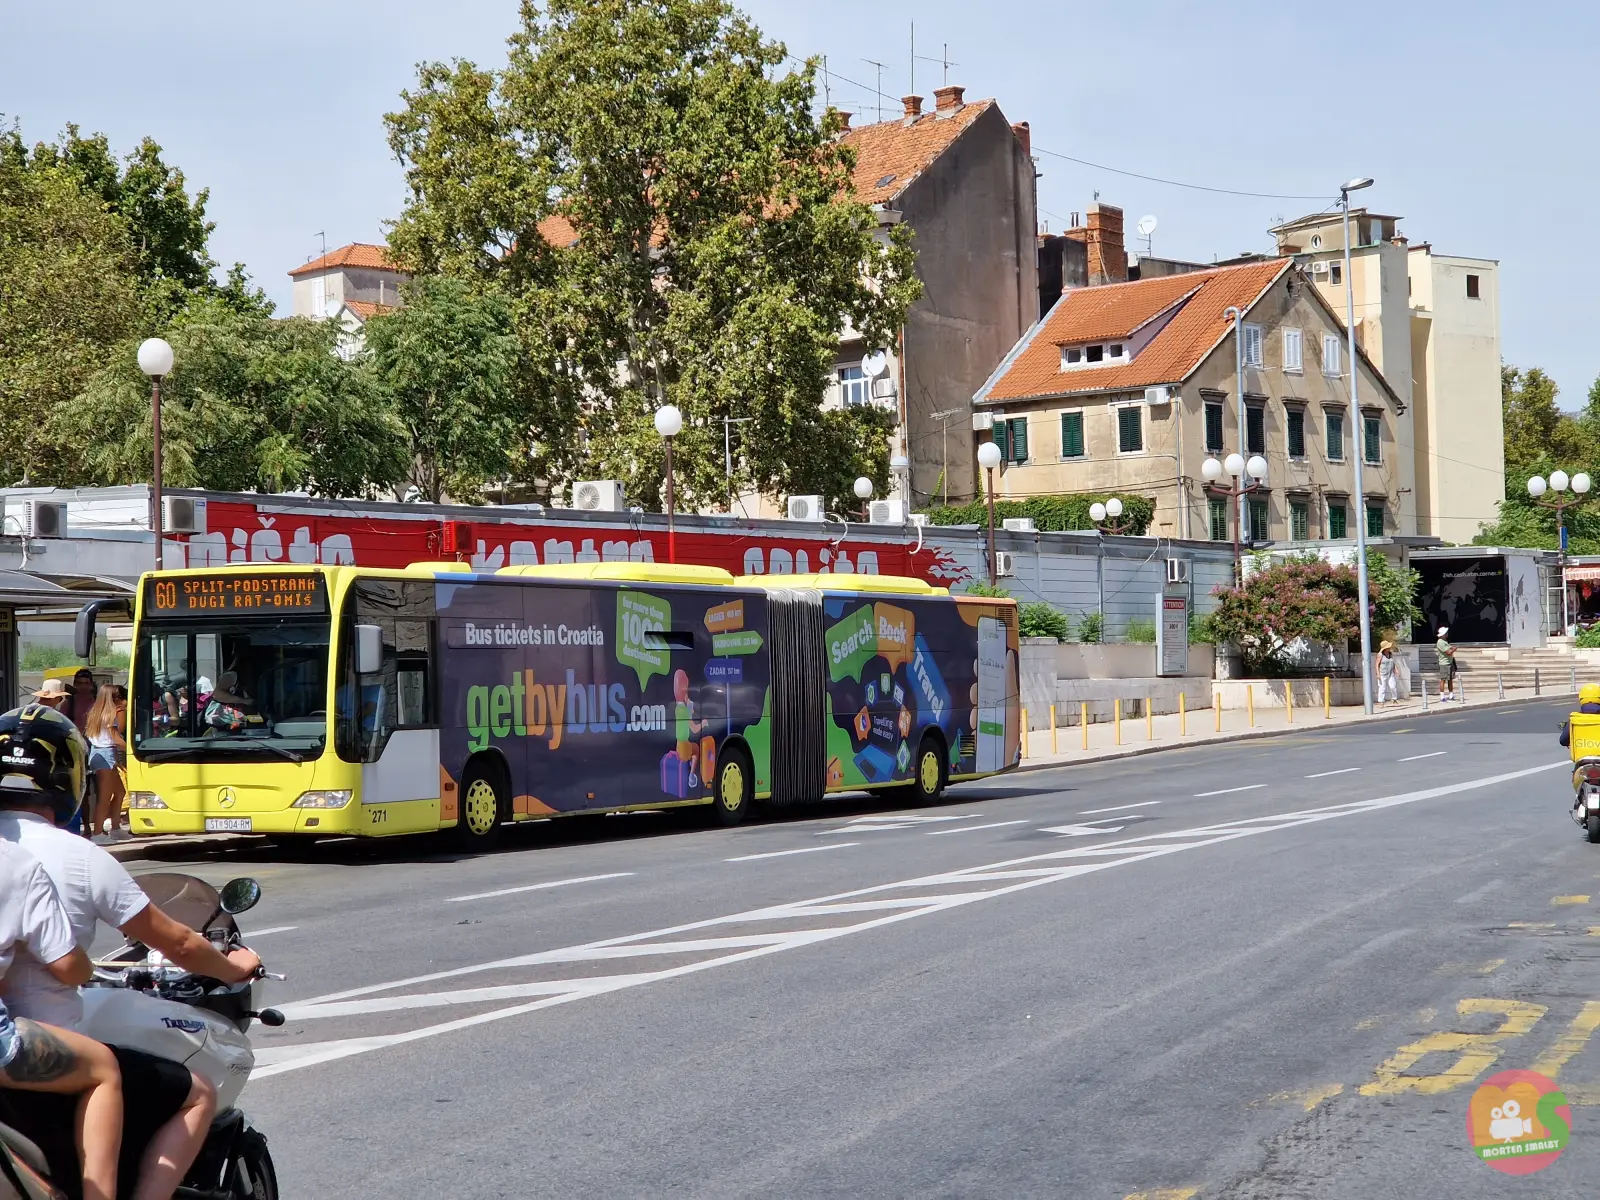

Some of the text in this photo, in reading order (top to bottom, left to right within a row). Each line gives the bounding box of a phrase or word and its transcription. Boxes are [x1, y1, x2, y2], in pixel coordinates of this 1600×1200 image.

[156, 581, 177, 609] 60
[189, 593, 313, 608] DUGI RAT-OMIŠ
[465, 623, 604, 646] Bus tickets in Croatia
[832, 619, 873, 664] Search
[879, 616, 907, 644] Book
[709, 666, 726, 676] ZADAR
[913, 646, 944, 723] Travel
[466, 668, 666, 754] getbybus.com
[1, 755, 36, 765] SHARK
[372, 809, 388, 823] 271
[161, 1017, 207, 1033] TRIUMPH
